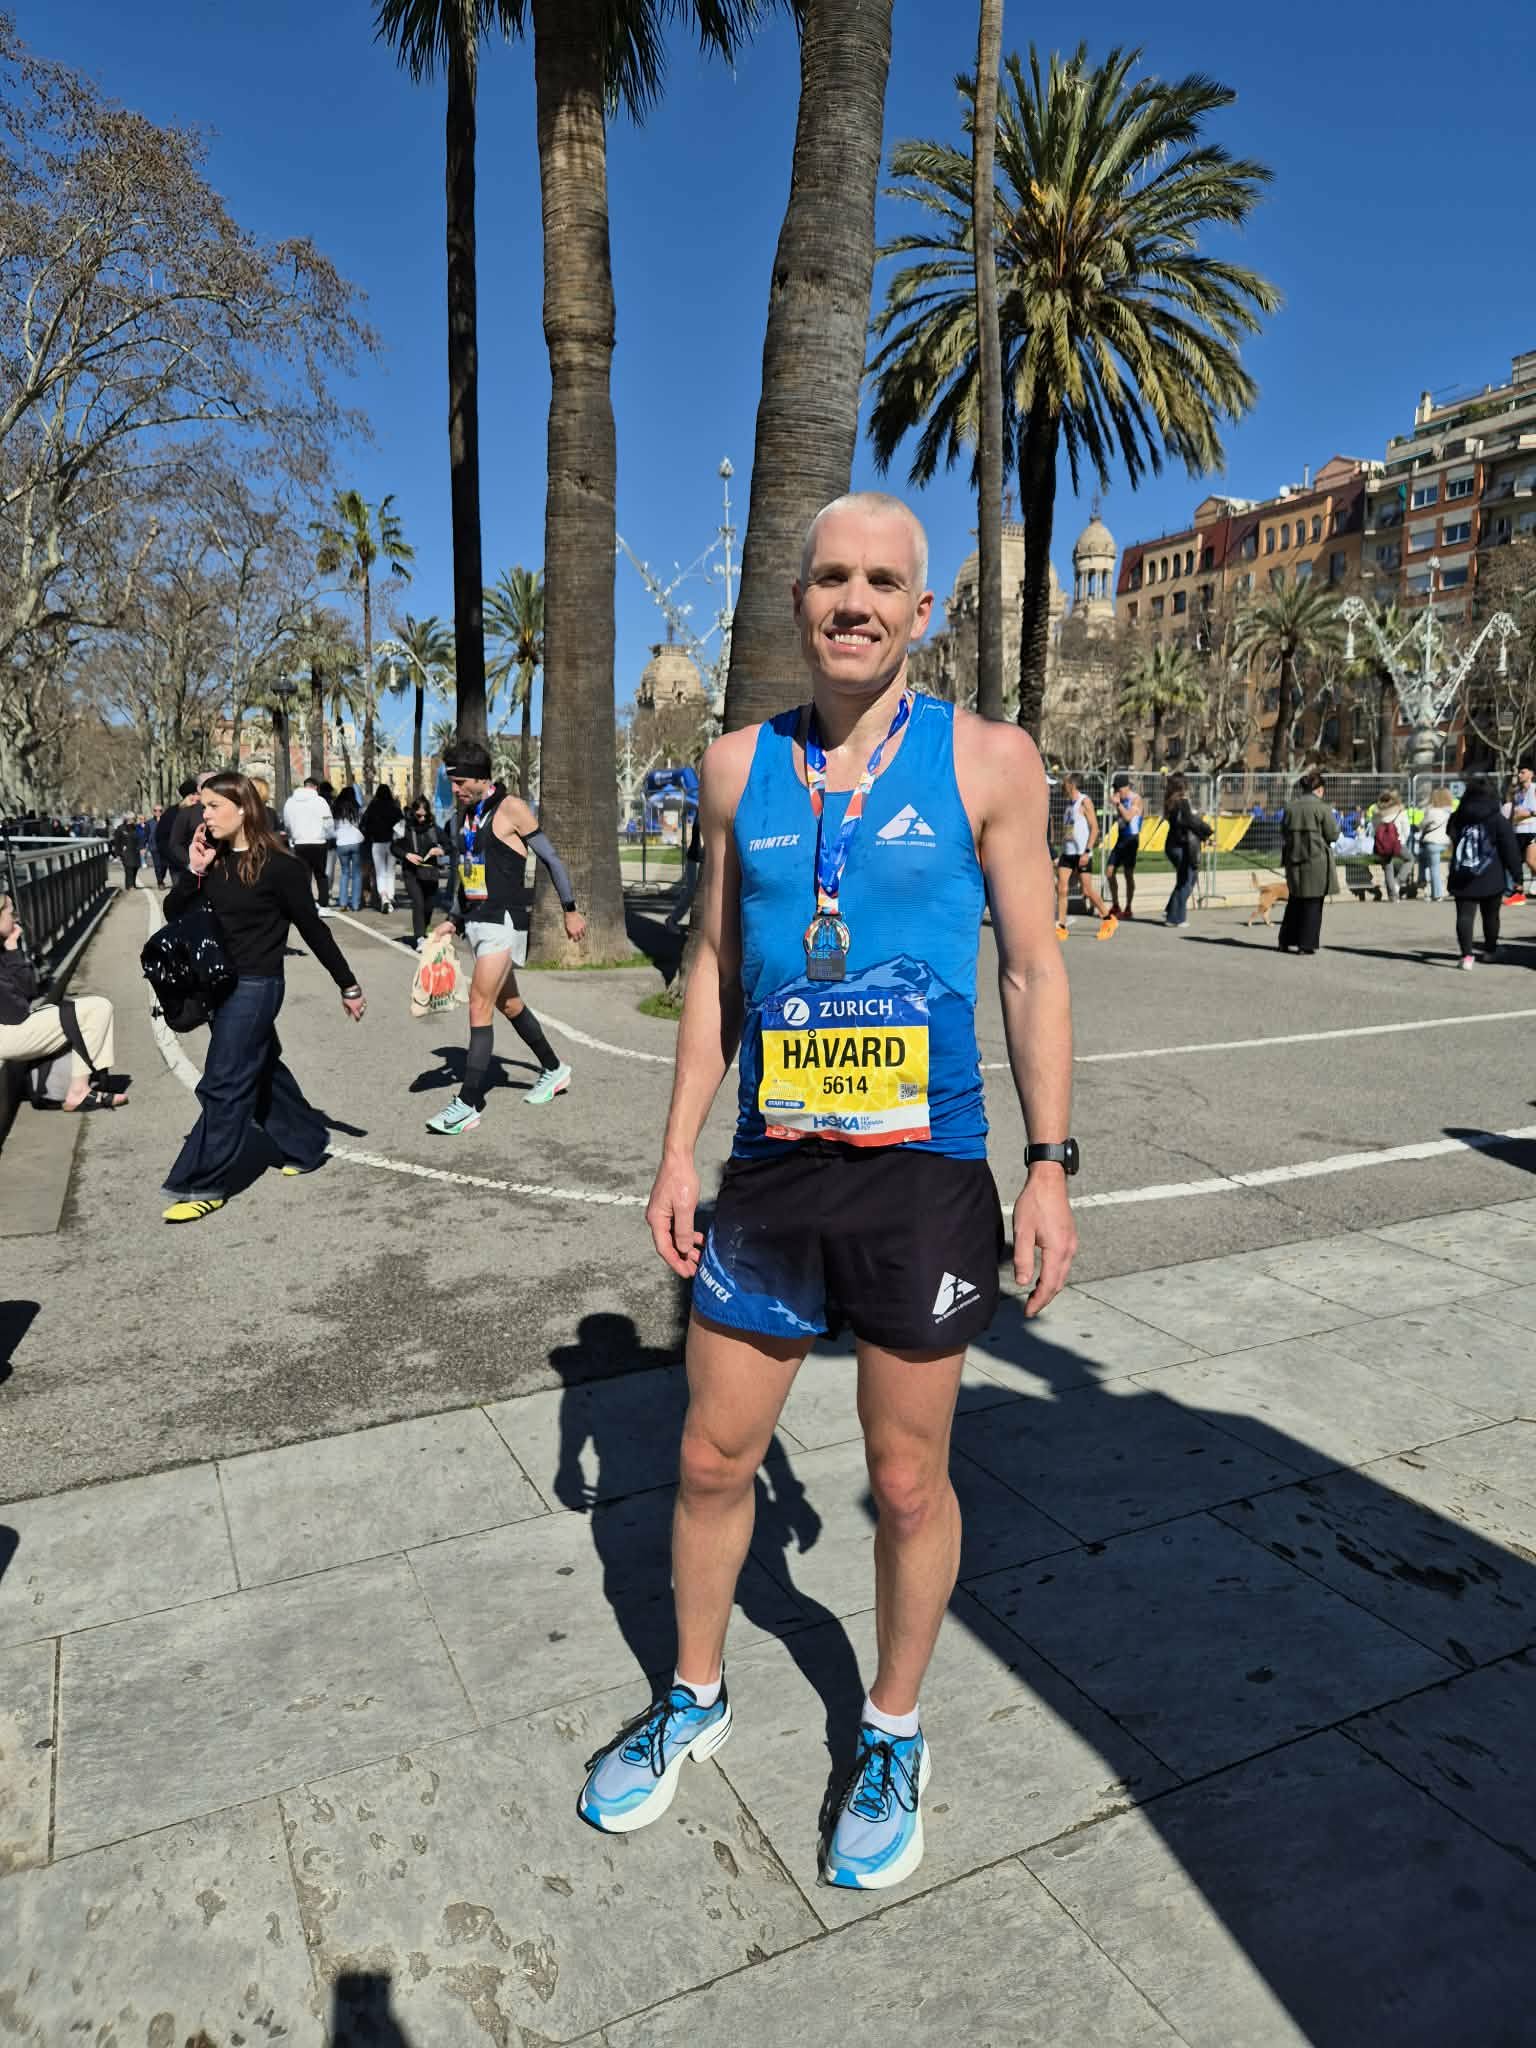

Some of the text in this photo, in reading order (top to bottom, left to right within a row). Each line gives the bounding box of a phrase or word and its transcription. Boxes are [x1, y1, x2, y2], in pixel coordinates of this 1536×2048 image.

[749, 833, 800, 852] TRIMTEX
[819, 999, 893, 1017] ZURICH
[783, 1029, 906, 1069] HÅVARD
[823, 1076, 869, 1094] 5614
[813, 1115, 860, 1131] HOKA
